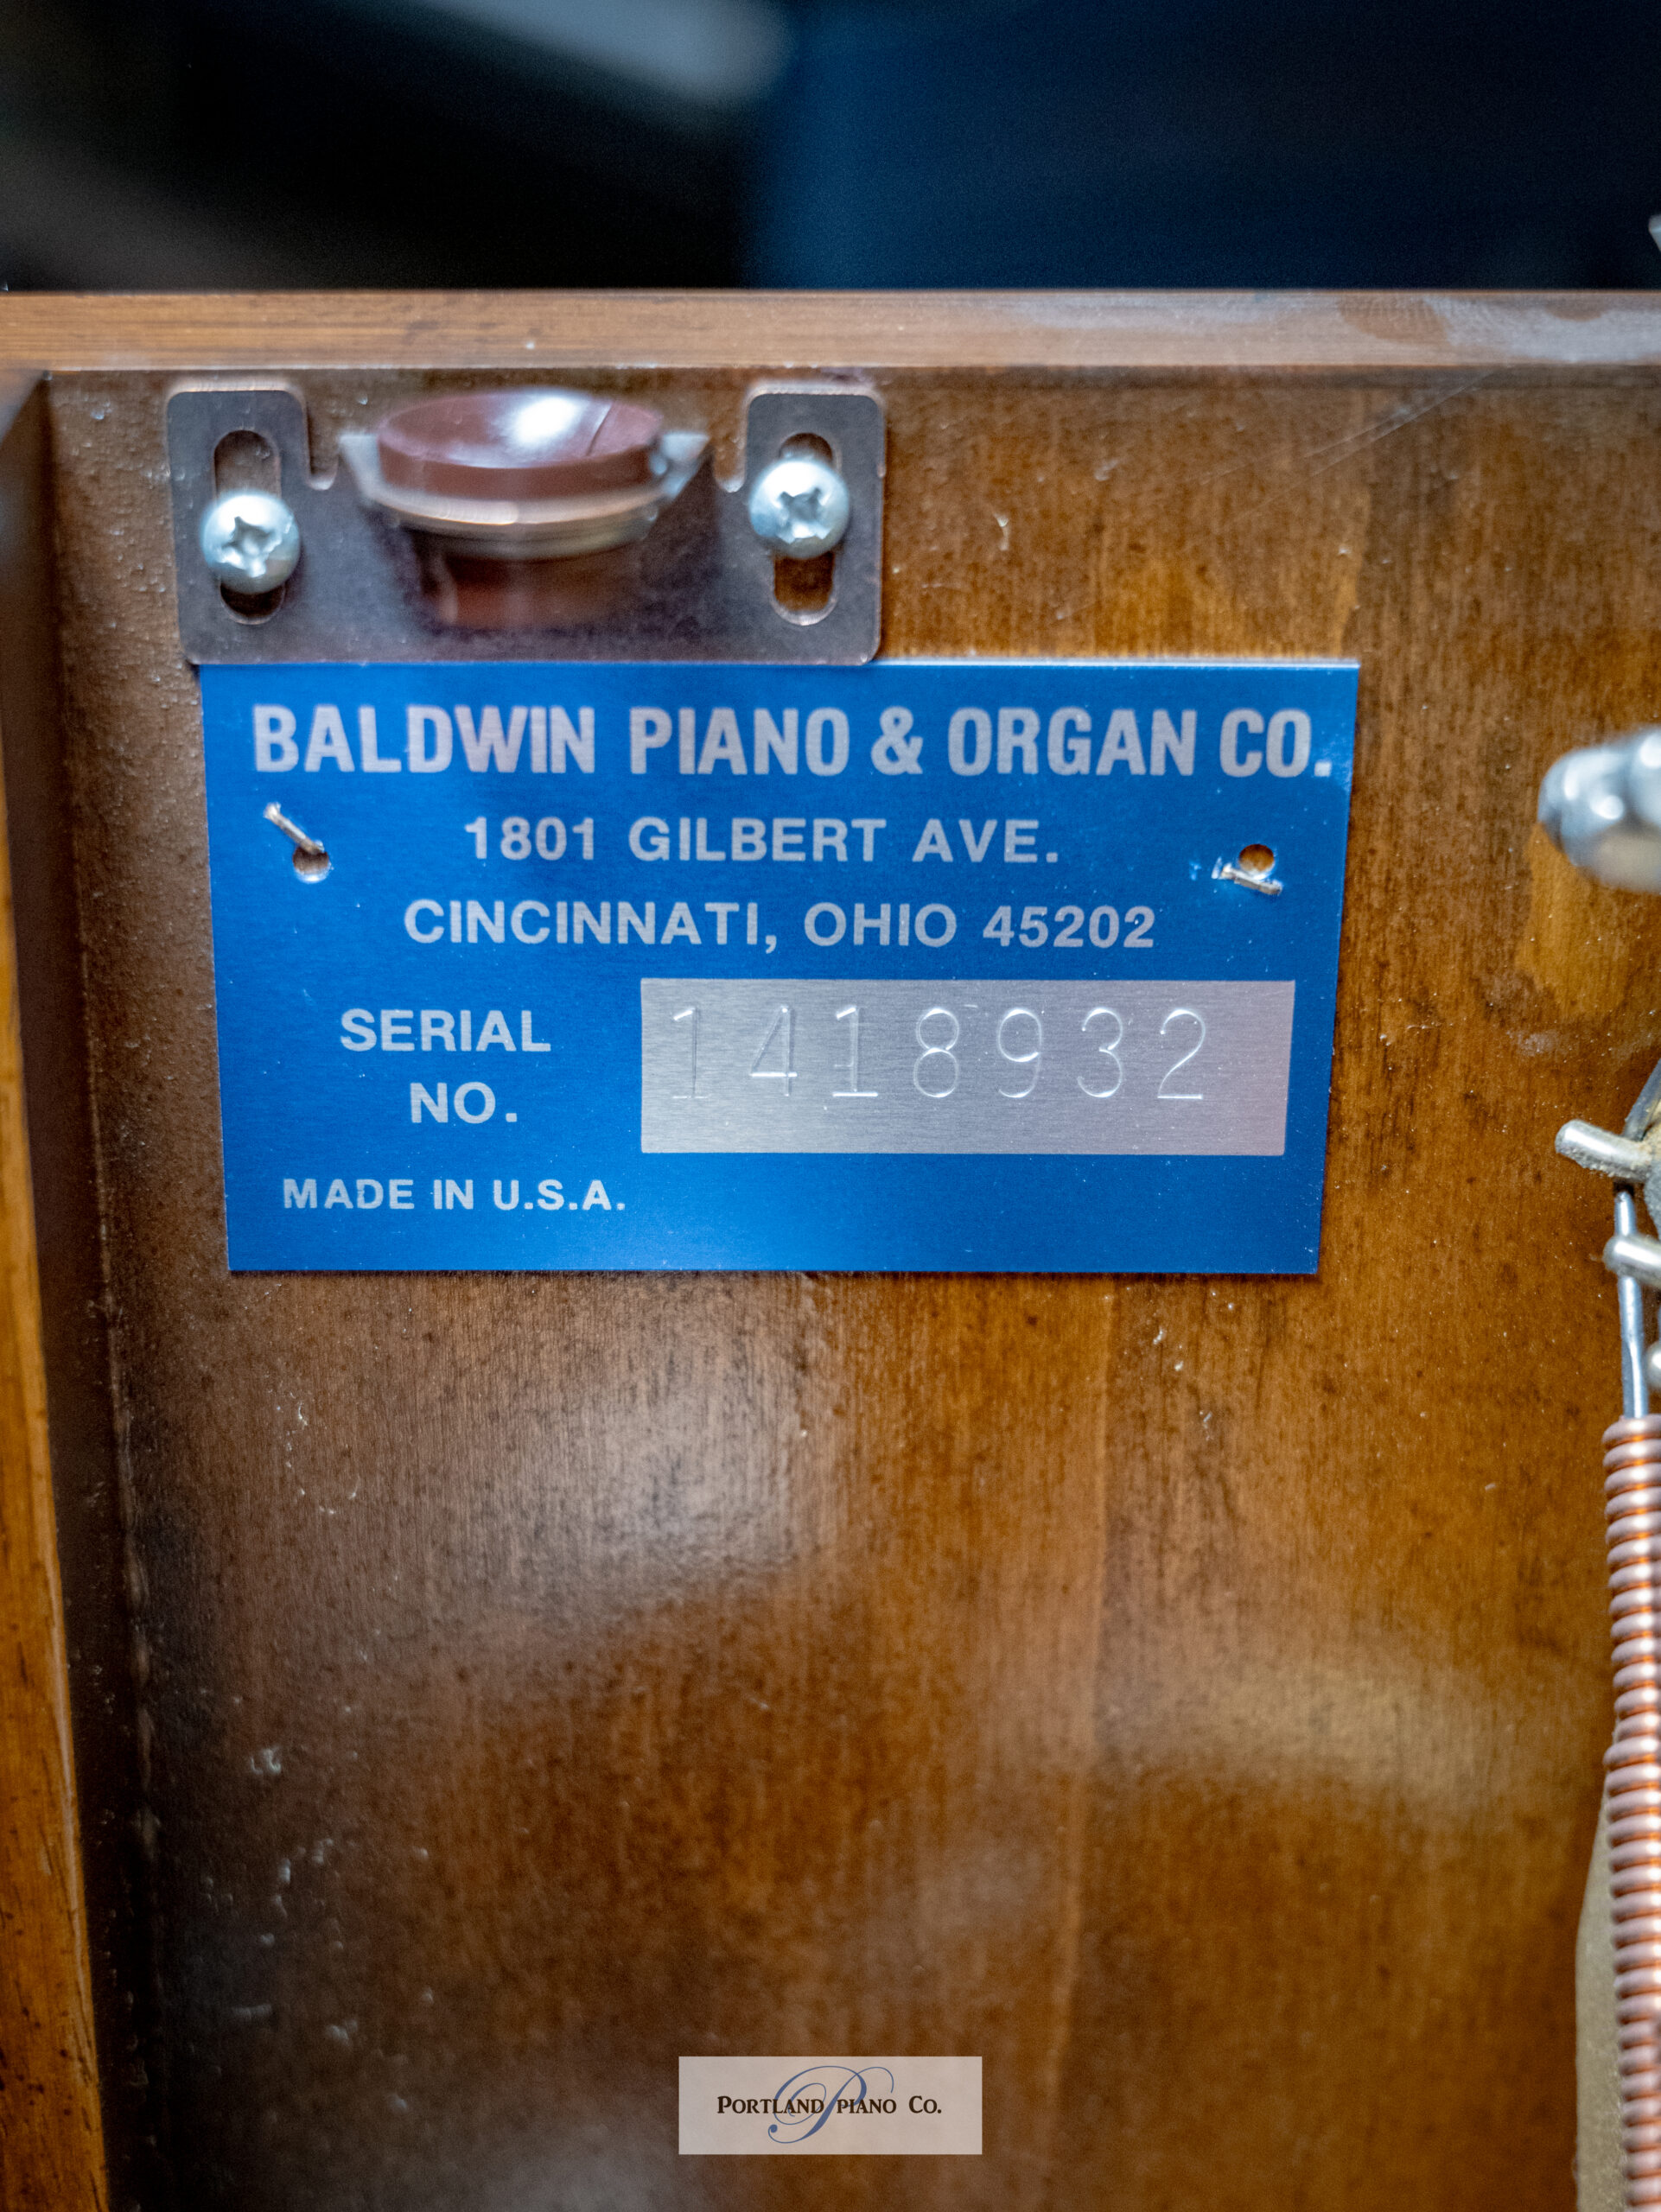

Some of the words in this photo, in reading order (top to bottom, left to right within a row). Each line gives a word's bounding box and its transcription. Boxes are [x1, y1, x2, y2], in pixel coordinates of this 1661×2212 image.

[253, 705, 595, 774] BALDWIN
[631, 707, 850, 776] PIANO
[871, 706, 924, 776] &
[948, 708, 1198, 777] ORGAN
[1219, 709, 1333, 779] CO.
[465, 817, 595, 861] 1801
[628, 818, 888, 862] GILBERT
[912, 819, 1059, 862] AVE.
[404, 899, 777, 953] CINCINNATI,
[804, 903, 958, 947] OHIO
[983, 906, 1156, 949] 45202
[340, 1009, 551, 1053] SERIAL
[671, 1005, 1207, 1101] 1418932
[410, 1082, 519, 1124] NO.
[283, 1179, 415, 1210] MADE
[433, 1179, 474, 1210] IN
[493, 1179, 625, 1211] U.S.A.
